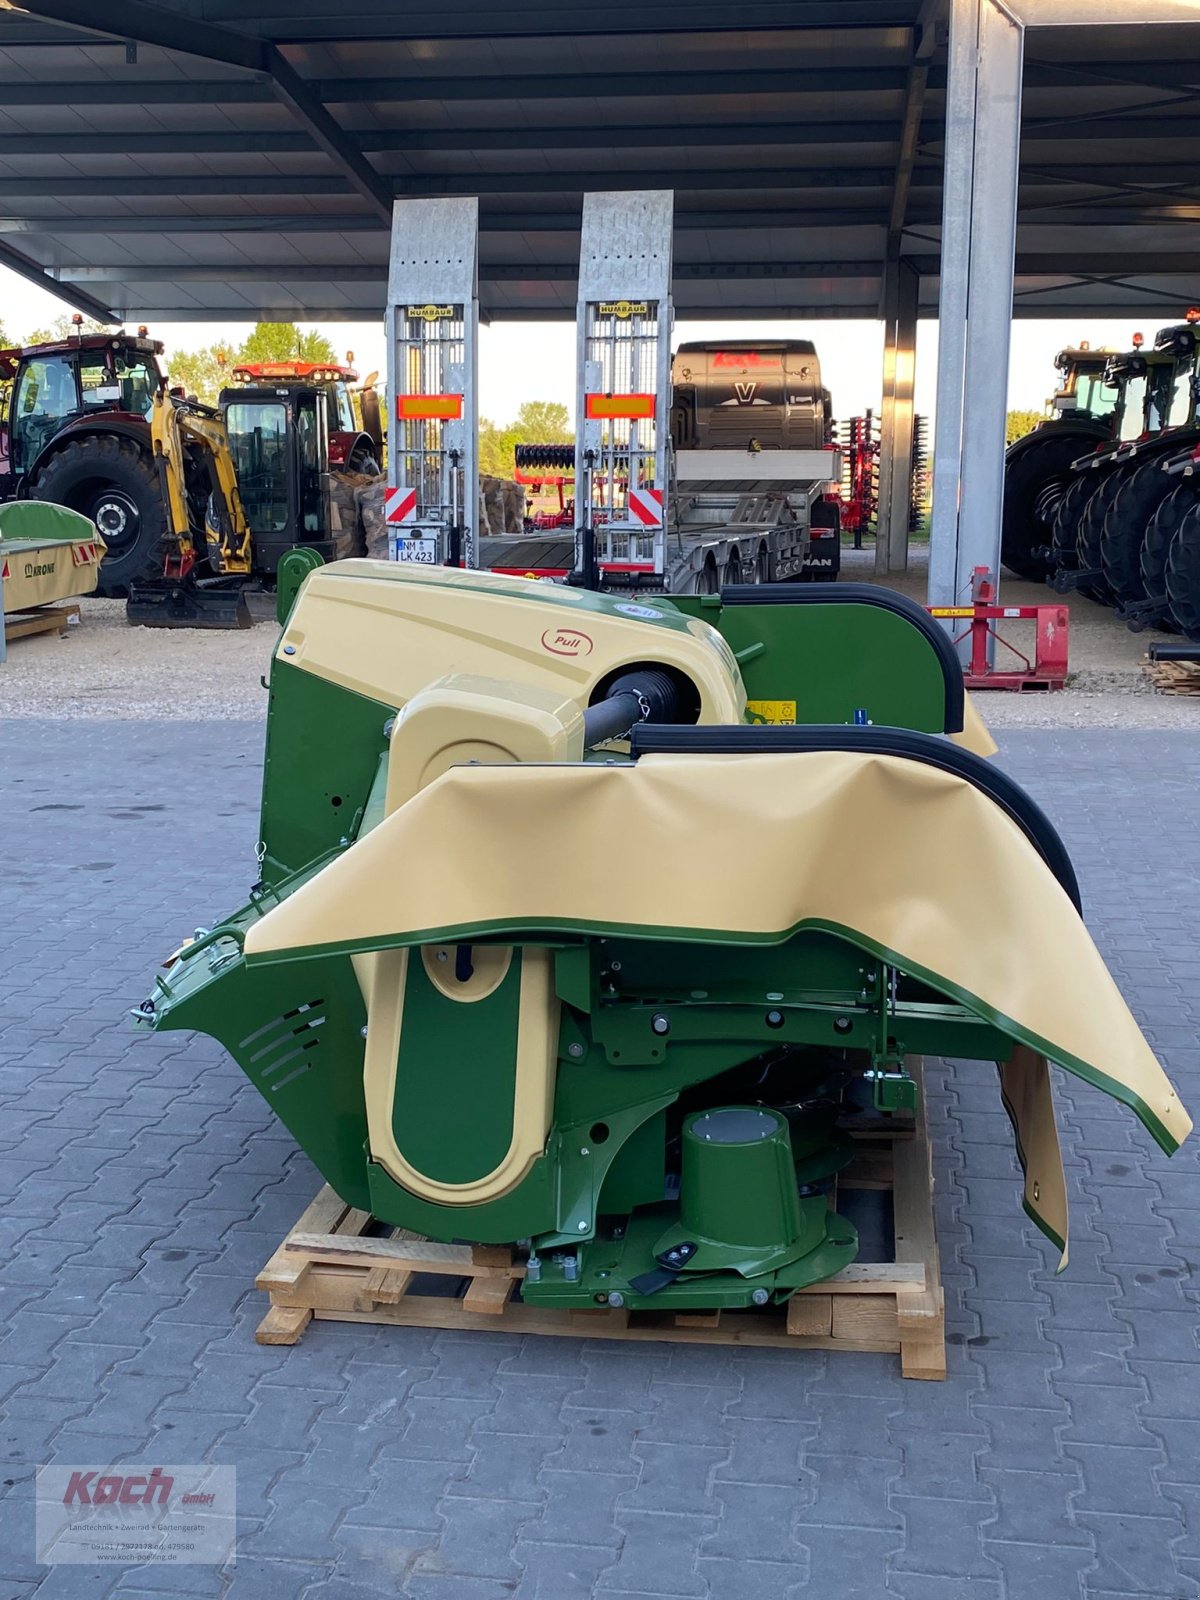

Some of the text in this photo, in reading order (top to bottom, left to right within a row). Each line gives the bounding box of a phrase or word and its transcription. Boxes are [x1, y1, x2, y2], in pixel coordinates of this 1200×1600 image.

[403, 541, 416, 551] NM
[400, 551, 433, 562] LK 423
[33, 563, 55, 576] KRONE
[554, 636, 581, 648] Pull
